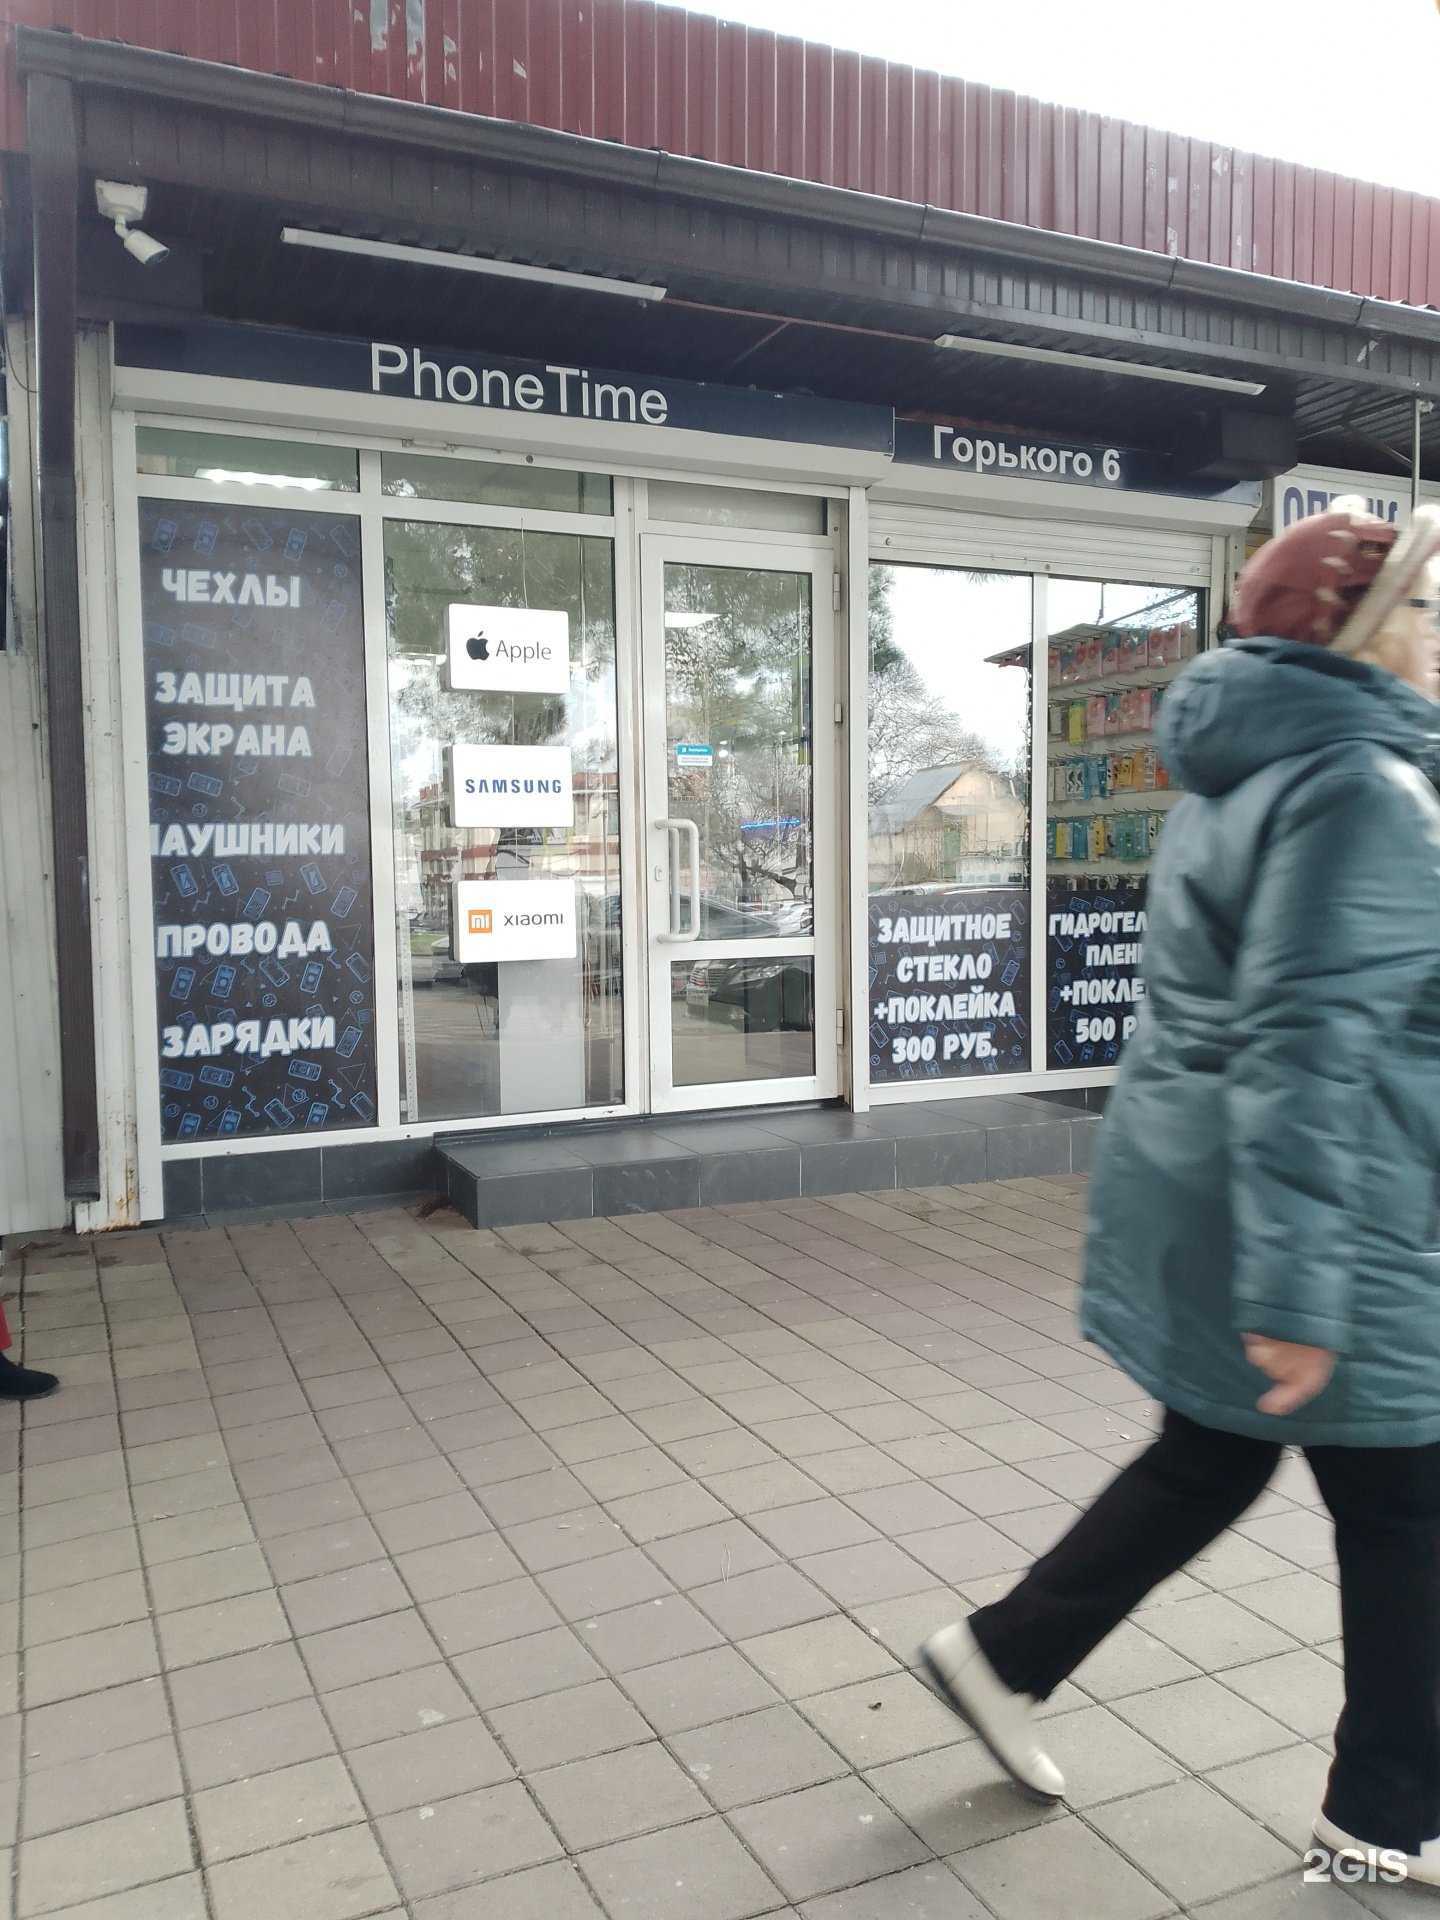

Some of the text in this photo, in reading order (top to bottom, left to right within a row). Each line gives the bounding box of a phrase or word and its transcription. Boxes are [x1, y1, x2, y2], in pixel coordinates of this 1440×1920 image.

[371, 343, 668, 424] PhoneTime
[933, 426, 1122, 482] Горького 6
[161, 567, 302, 610] ЧЕХЛЫ
[495, 639, 553, 663] Apple
[154, 671, 317, 713] ЗАЩИТА
[161, 722, 313, 759] ЭКРАНА
[465, 778, 562, 795] SAMSUNG
[156, 919, 334, 960] ПРОВОДА
[877, 912, 1013, 946] ЗАЩИТНОЕ
[1048, 911, 1148, 938] ГИДРОГЕЛ
[896, 953, 992, 983] СТЕКЛО
[1086, 942, 1143, 966] ПЛЕН
[874, 984, 1016, 1024] +ПОКЛЕЙКА
[1060, 977, 1149, 1005] +ПОКЛЕ
[162, 1016, 336, 1059] ЗАРЯДКИ
[1075, 1016, 1116, 1043] 500
[891, 1031, 998, 1064] 300 РУБ.
